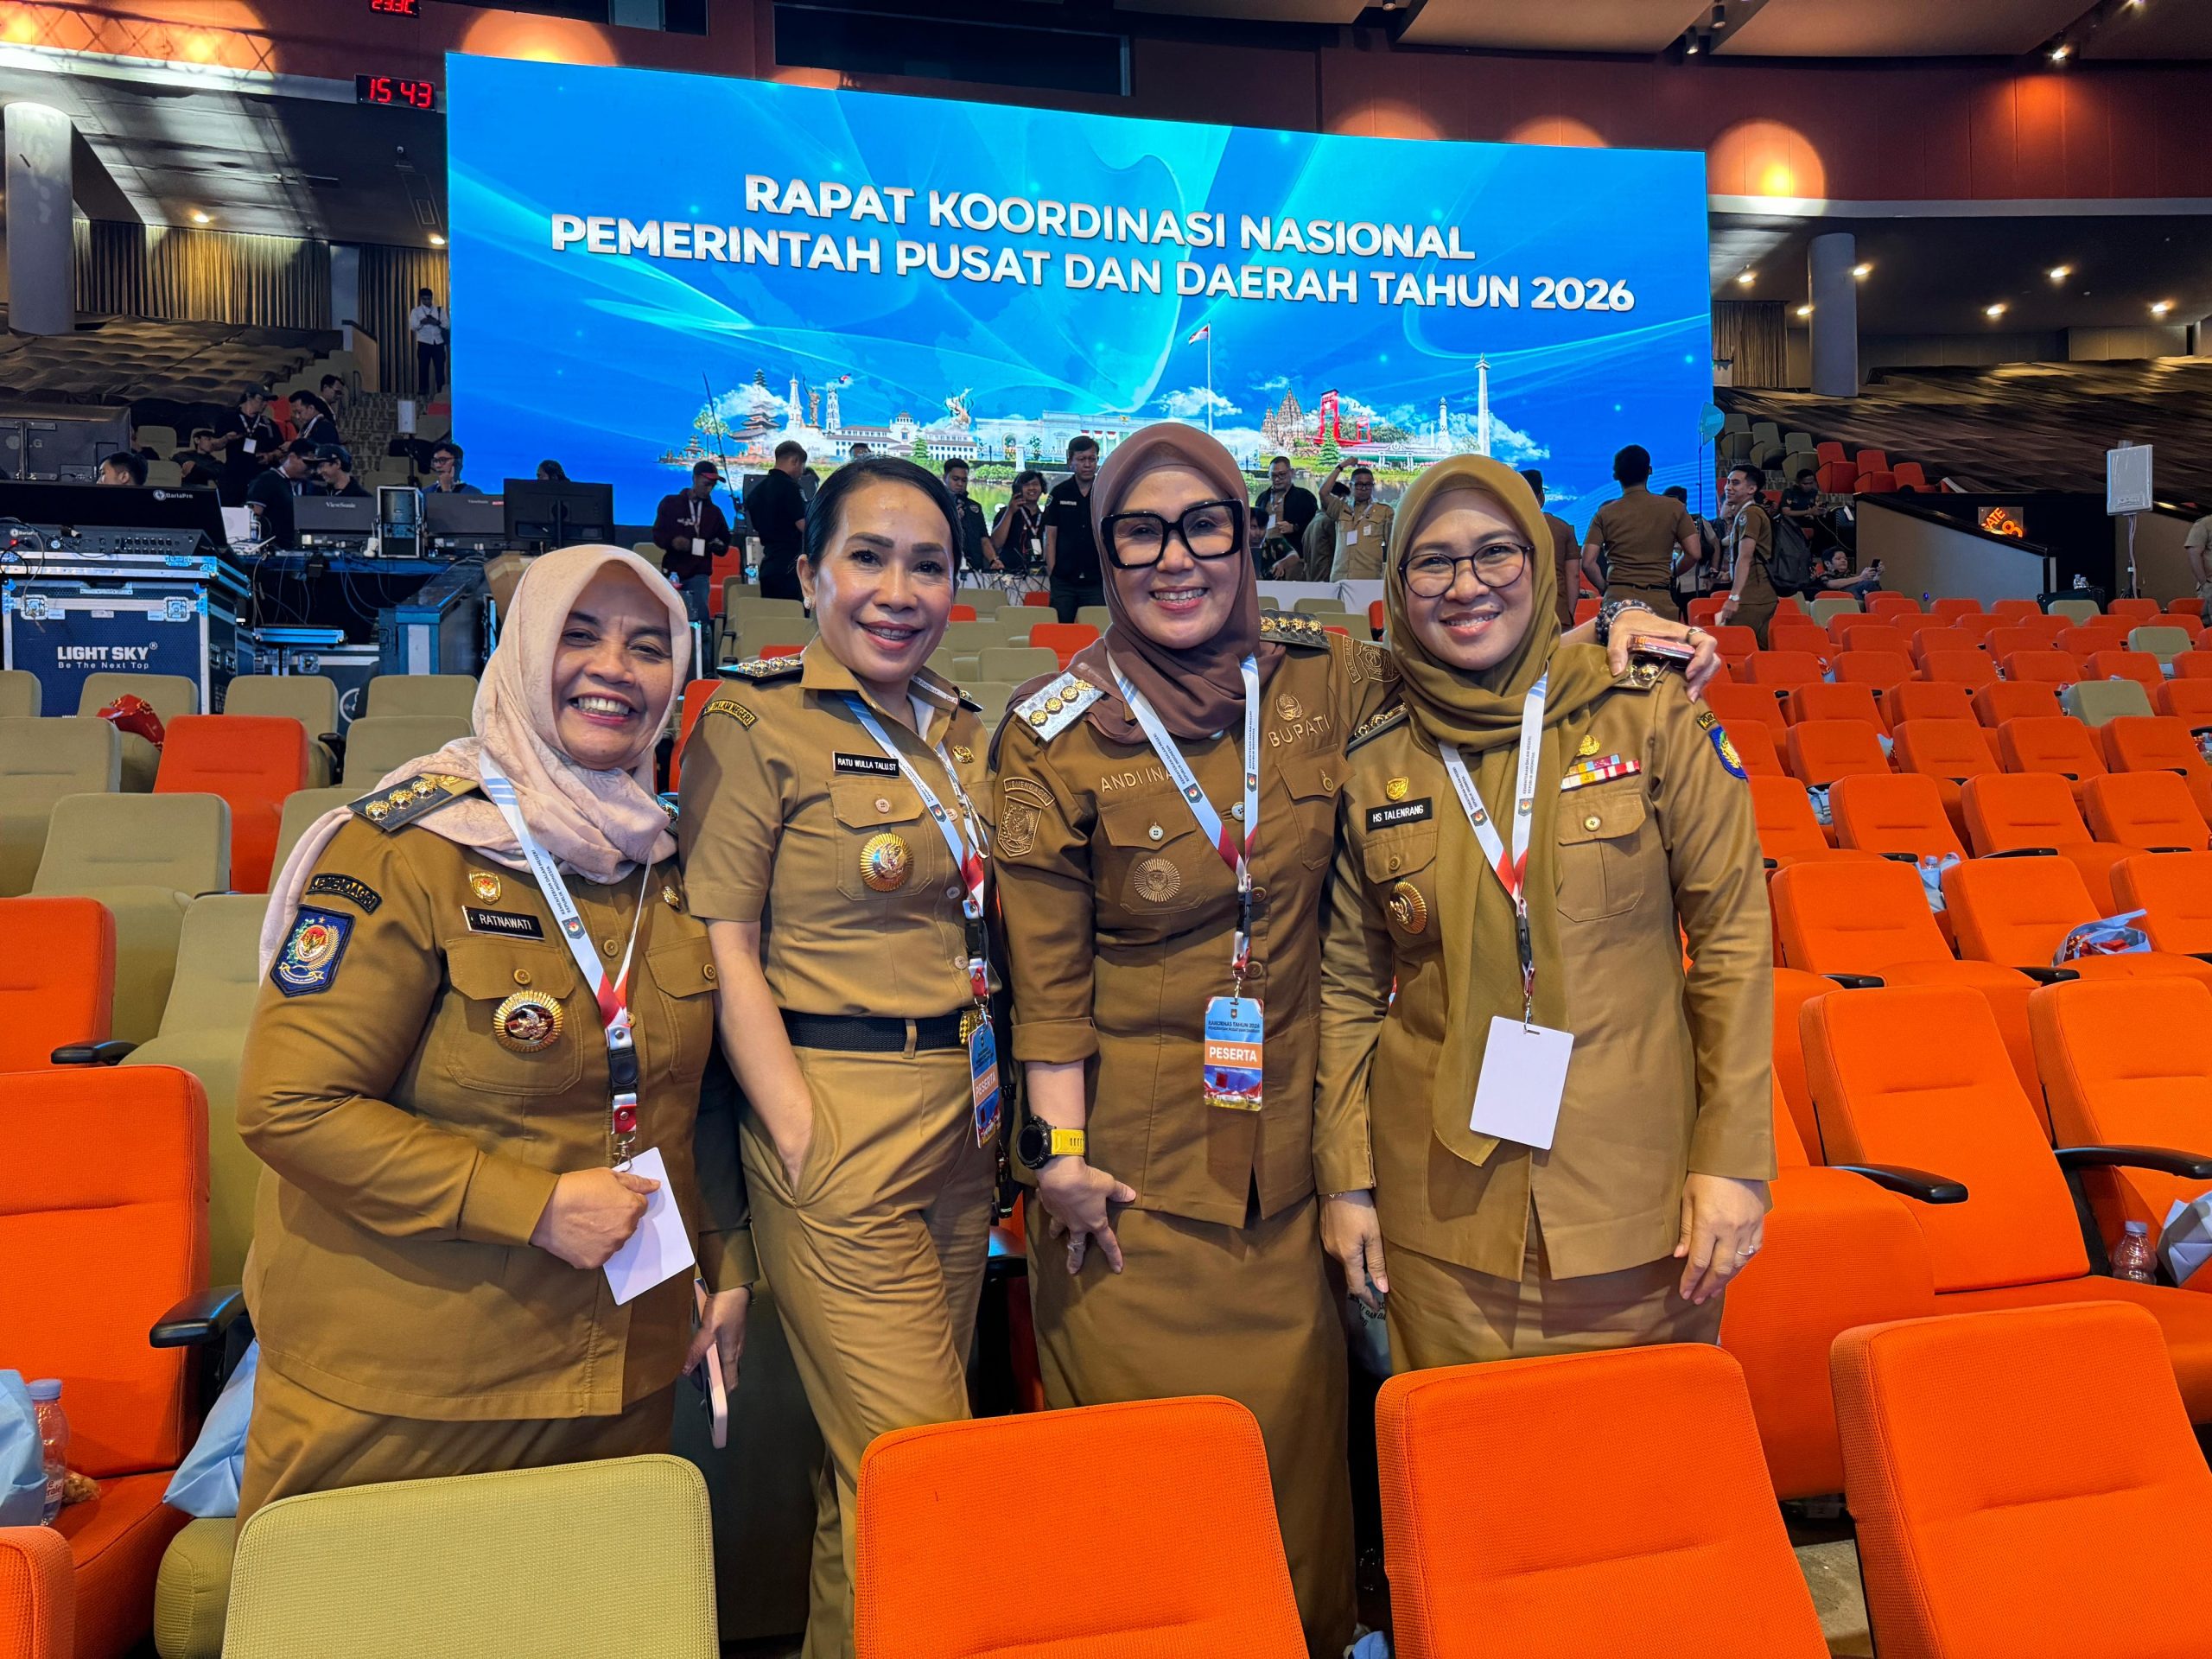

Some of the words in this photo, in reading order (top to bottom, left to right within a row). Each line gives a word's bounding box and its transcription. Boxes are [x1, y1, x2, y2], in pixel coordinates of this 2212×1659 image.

[370, 78, 392, 103] 15
[400, 82, 432, 108] 43
[745, 174, 914, 224] RAPAT
[928, 189, 1226, 248] KOORDINASI
[1240, 213, 1476, 260] NASIONAL
[550, 213, 881, 274] PEMERINTAH
[895, 239, 1050, 286] PUSAT
[1065, 252, 1161, 295] DAN
[1175, 259, 1358, 304] DAERAH
[1370, 270, 1520, 309] TAHUN
[1530, 276, 1636, 312] 2026
[57, 646, 109, 660] LIGHT
[111, 646, 149, 660] SKY
[130, 661, 149, 670] Top
[1268, 713, 1331, 747] BUPATI
[837, 758, 854, 767] RATU
[855, 760, 874, 769] WULLA
[1101, 770, 1143, 793] ANDI
[1372, 812, 1382, 823] HS
[1383, 804, 1424, 821] TALENRANG
[479, 913, 532, 931] RATNAWATI
[1209, 1046, 1257, 1064] PESERTA
[976, 1071, 996, 1097] PESERTA
